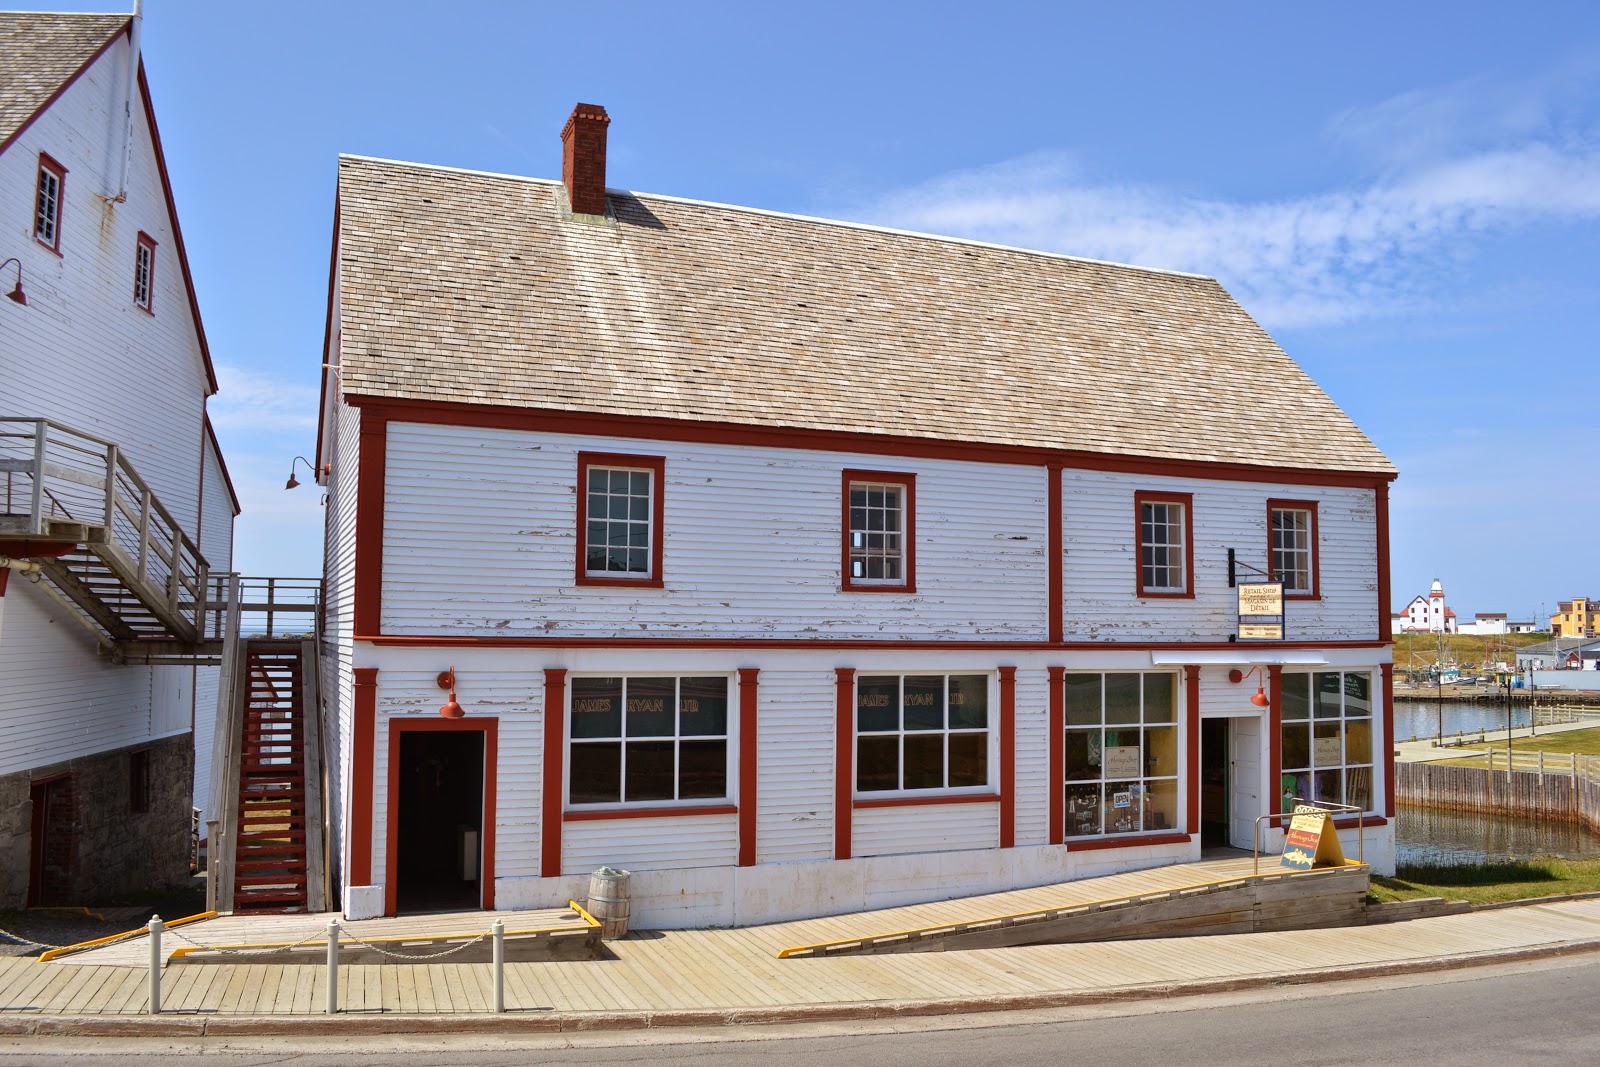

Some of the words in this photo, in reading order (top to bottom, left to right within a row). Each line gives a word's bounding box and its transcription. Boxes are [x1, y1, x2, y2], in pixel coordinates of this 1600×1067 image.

[572, 699, 611, 712] JAMES
[627, 700, 664, 712] RYAN
[1116, 794, 1129, 803] OPEN
